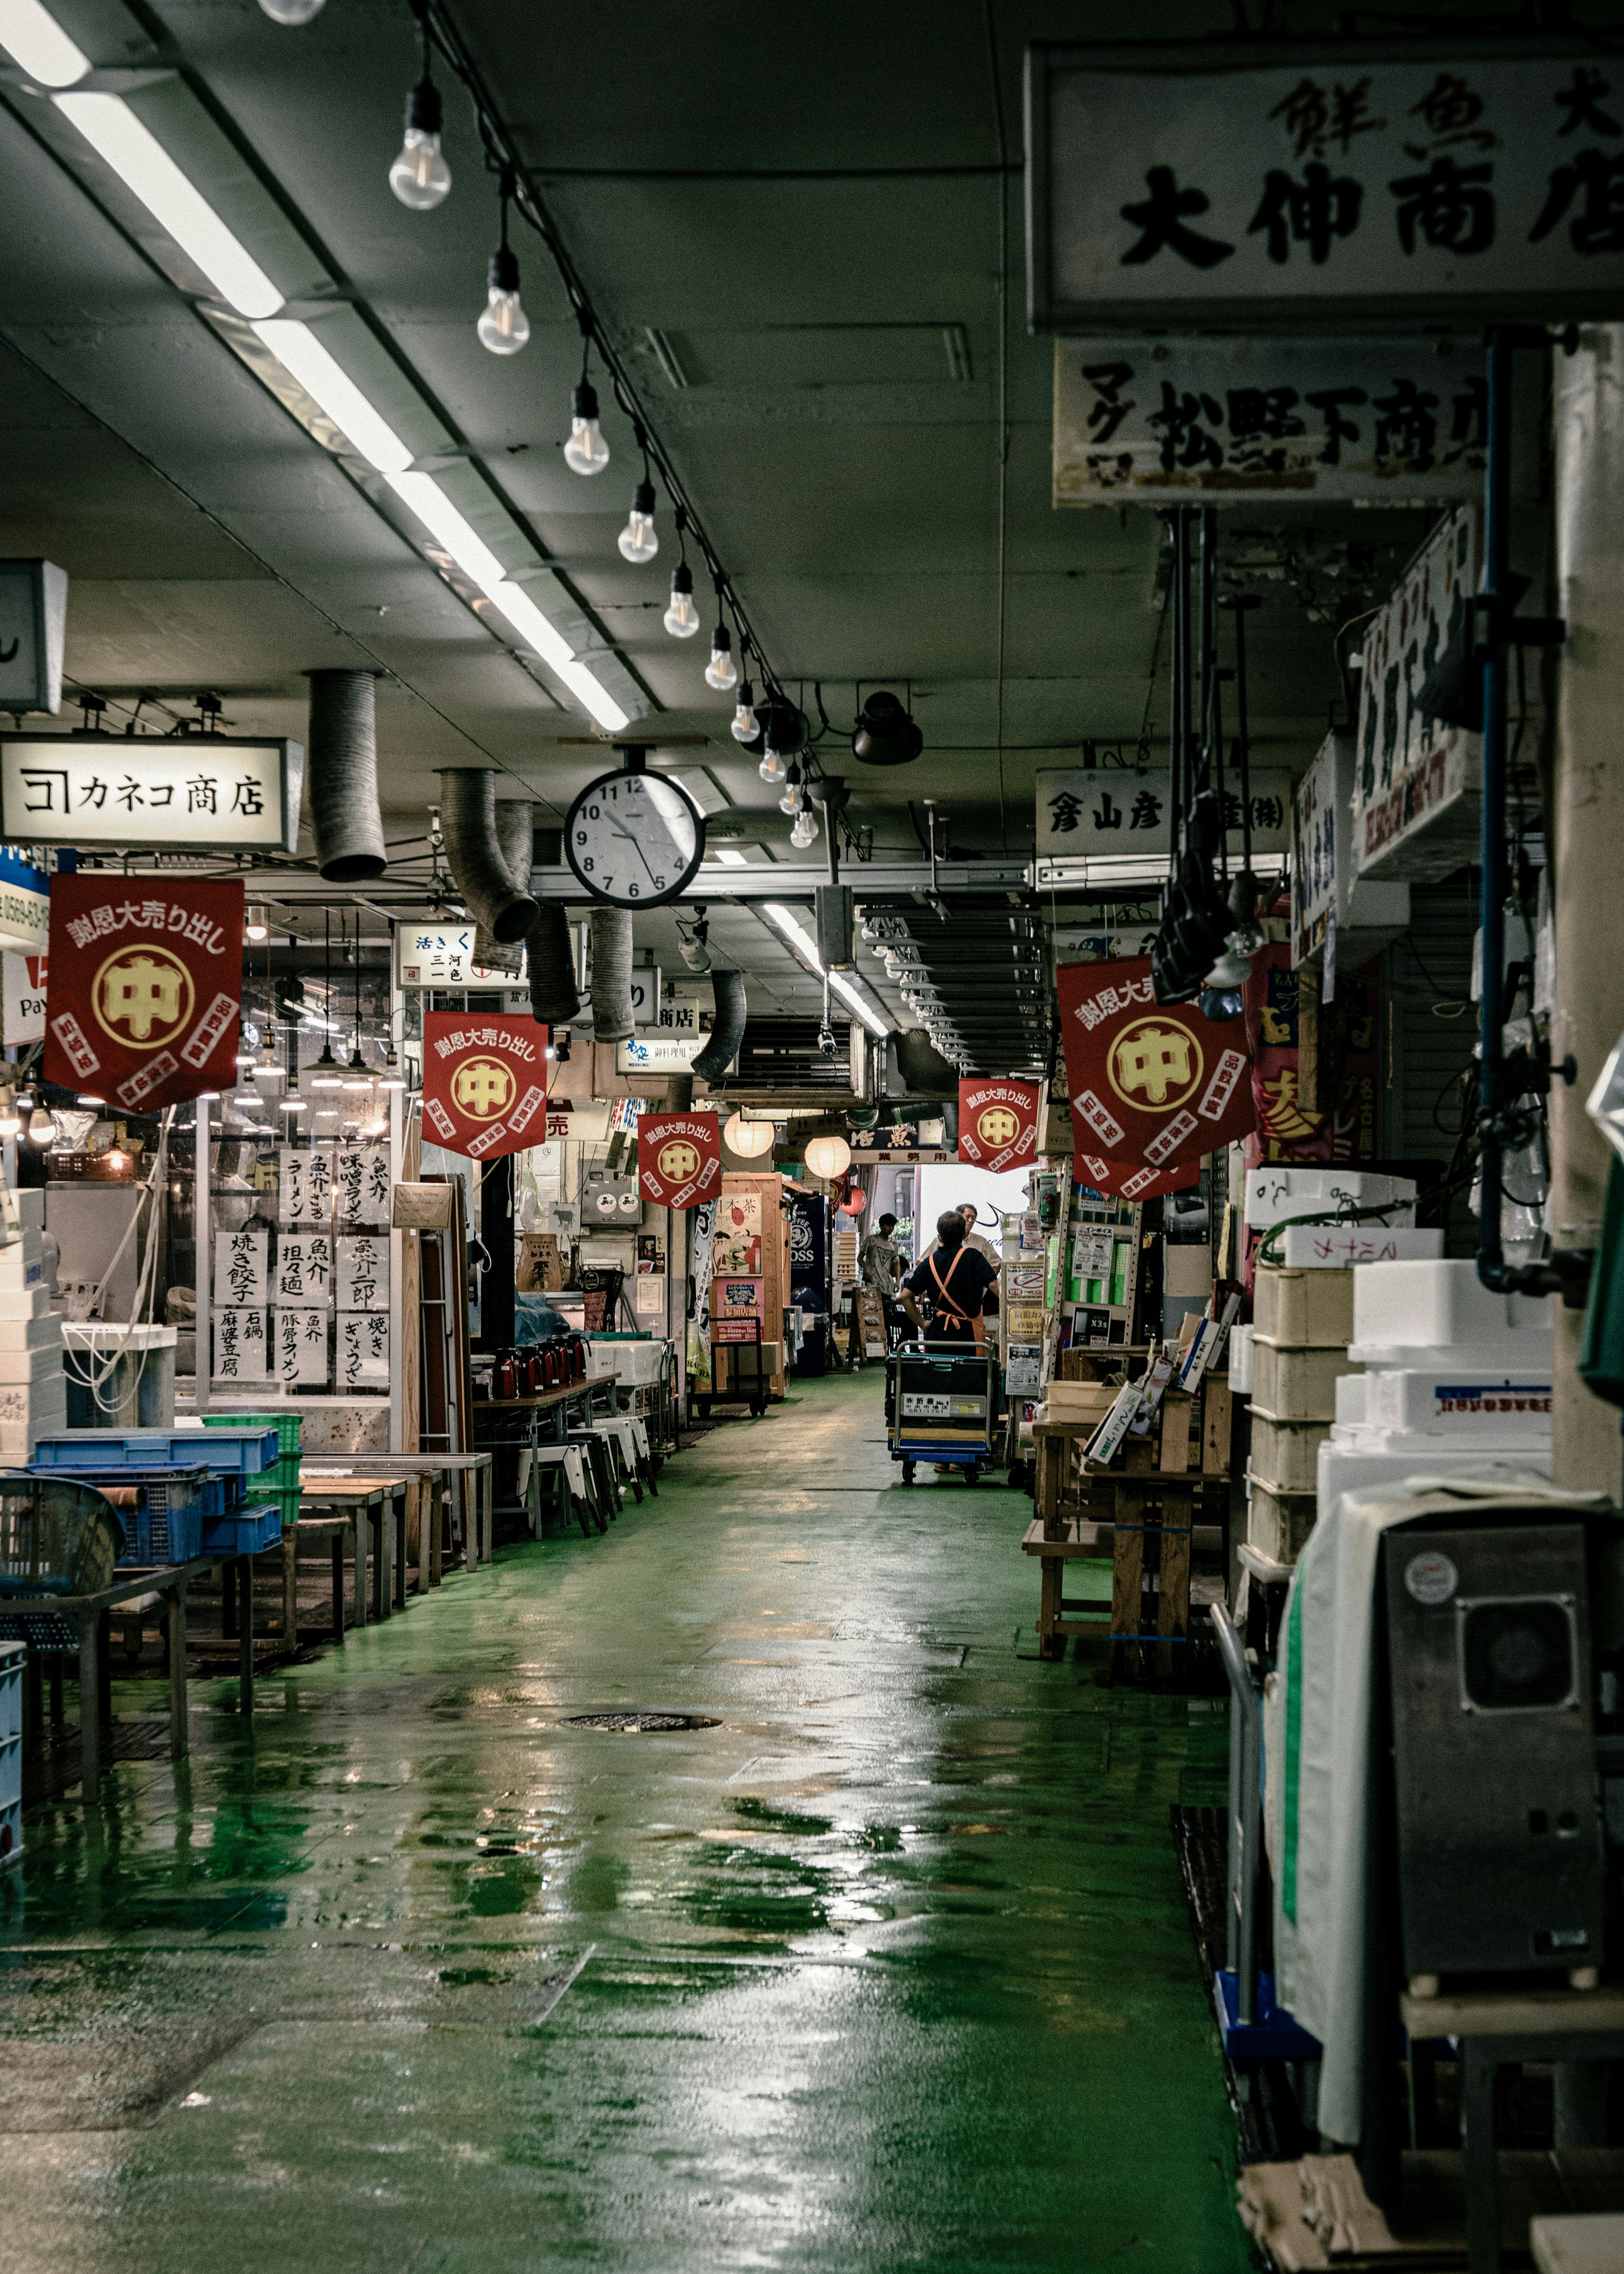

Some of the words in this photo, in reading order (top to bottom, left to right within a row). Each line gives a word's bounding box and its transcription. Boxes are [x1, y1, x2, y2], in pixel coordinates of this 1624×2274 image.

[599, 785, 617, 800] 11
[625, 779, 645, 793] 12
[580, 805, 600, 820] 10
[577, 831, 587, 845] 9
[584, 857, 594, 871] 8
[674, 857, 684, 871] 4
[603, 876, 613, 890] 7
[629, 883, 639, 897] 6
[655, 876, 665, 890] 5
[65, 899, 226, 956] 謝恩大売り出し
[431, 954, 462, 967] 三河
[431, 969, 463, 982] 一色
[433, 1027, 536, 1063] 謝恩大売り出し
[644, 1122, 712, 1145] 謝恩大売り出し
[878, 1152, 946, 1162] 業務用
[368, 1155, 389, 1203] 魚介
[288, 1159, 304, 1218] ラーメン
[306, 1239, 329, 1285] 魚介
[530, 1250, 552, 1259] 知多牛
[226, 1234, 258, 1303] 焼き餃子
[724, 1307, 757, 1317] 参加店舗
[243, 1312, 263, 1340] 石鍋
[305, 1315, 324, 1343] 魚介
[1091, 1319, 1108, 1329] X3s
[219, 1310, 241, 1376] 麻婆豆腐
[367, 1317, 388, 1358] 焼き
[280, 1314, 301, 1382] 豚骨ラーメン
[344, 1321, 364, 1384] ぎょうざ
